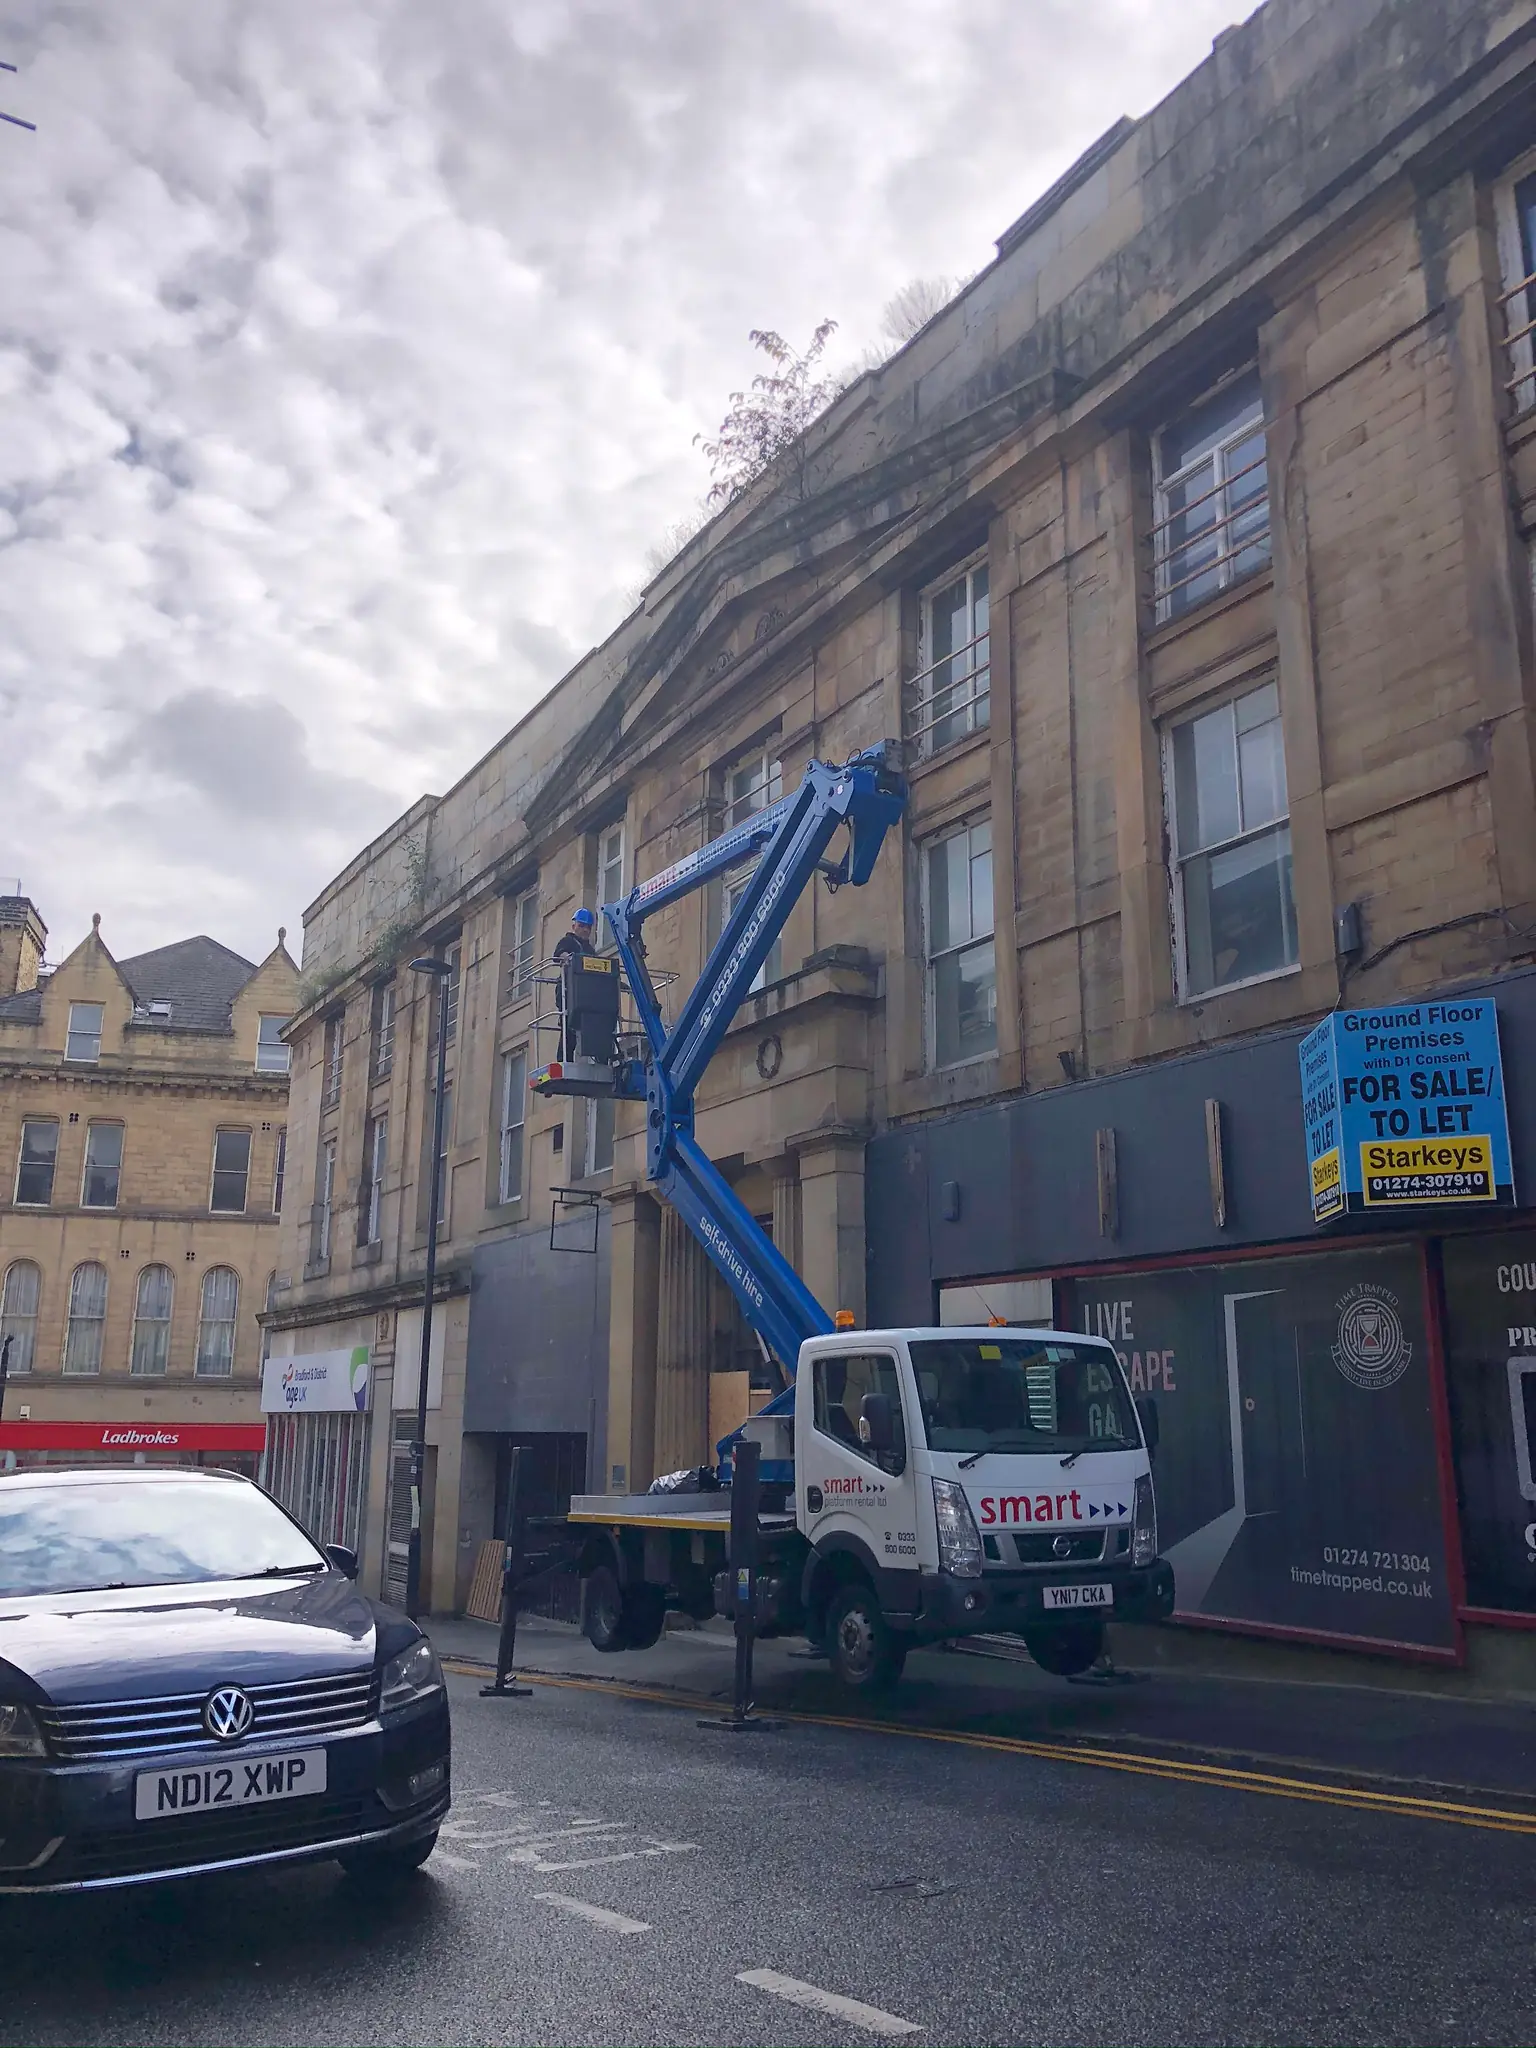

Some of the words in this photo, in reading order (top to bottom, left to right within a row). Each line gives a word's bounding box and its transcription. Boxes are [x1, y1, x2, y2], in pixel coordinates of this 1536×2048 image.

[712, 957, 739, 1007] 0333
[737, 920, 759, 959] 800
[756, 870, 786, 923] 6000
[1344, 1009, 1421, 1032] Ground
[1428, 1006, 1483, 1024] Floor
[1365, 1031, 1464, 1052] Premises
[1364, 1059, 1391, 1069] with
[1395, 1056, 1411, 1067] D1
[1415, 1051, 1471, 1065] Consent
[1343, 1074, 1401, 1104] FOR
[1410, 1066, 1495, 1100] SALE/
[1370, 1109, 1410, 1137] TO
[1419, 1104, 1473, 1134] LET
[1369, 1145, 1483, 1170] Starkeys
[1313, 1160, 1338, 1187] Starkeys
[1372, 1172, 1484, 1191] 01274-307910
[1386, 1187, 1472, 1198] www.starkeys.co.uk
[699, 1216, 743, 1279] self-drive
[742, 1270, 763, 1307] hire
[1334, 1287, 1357, 1311] TIME
[1357, 1282, 1399, 1307] TRAPPED
[1084, 1300, 1134, 1341] LIVE
[286, 1387, 299, 1408] age
[102, 1430, 179, 1444] Ladbrokes
[824, 1476, 863, 1494] smart
[825, 1497, 853, 1508] platform
[855, 1496, 876, 1507] rental
[980, 1489, 1083, 1524] smart
[898, 1532, 915, 1542] 0333
[885, 1545, 898, 1554] 800
[899, 1546, 917, 1555] 6000
[1323, 1546, 1369, 1567] 01274
[1372, 1551, 1431, 1573] 721304
[1290, 1566, 1433, 1599] timetrapped.co.uk
[1051, 1588, 1079, 1605] YN17
[1082, 1586, 1106, 1603] CKA
[157, 1768, 233, 1811] ND12
[243, 1758, 306, 1798] XWP
